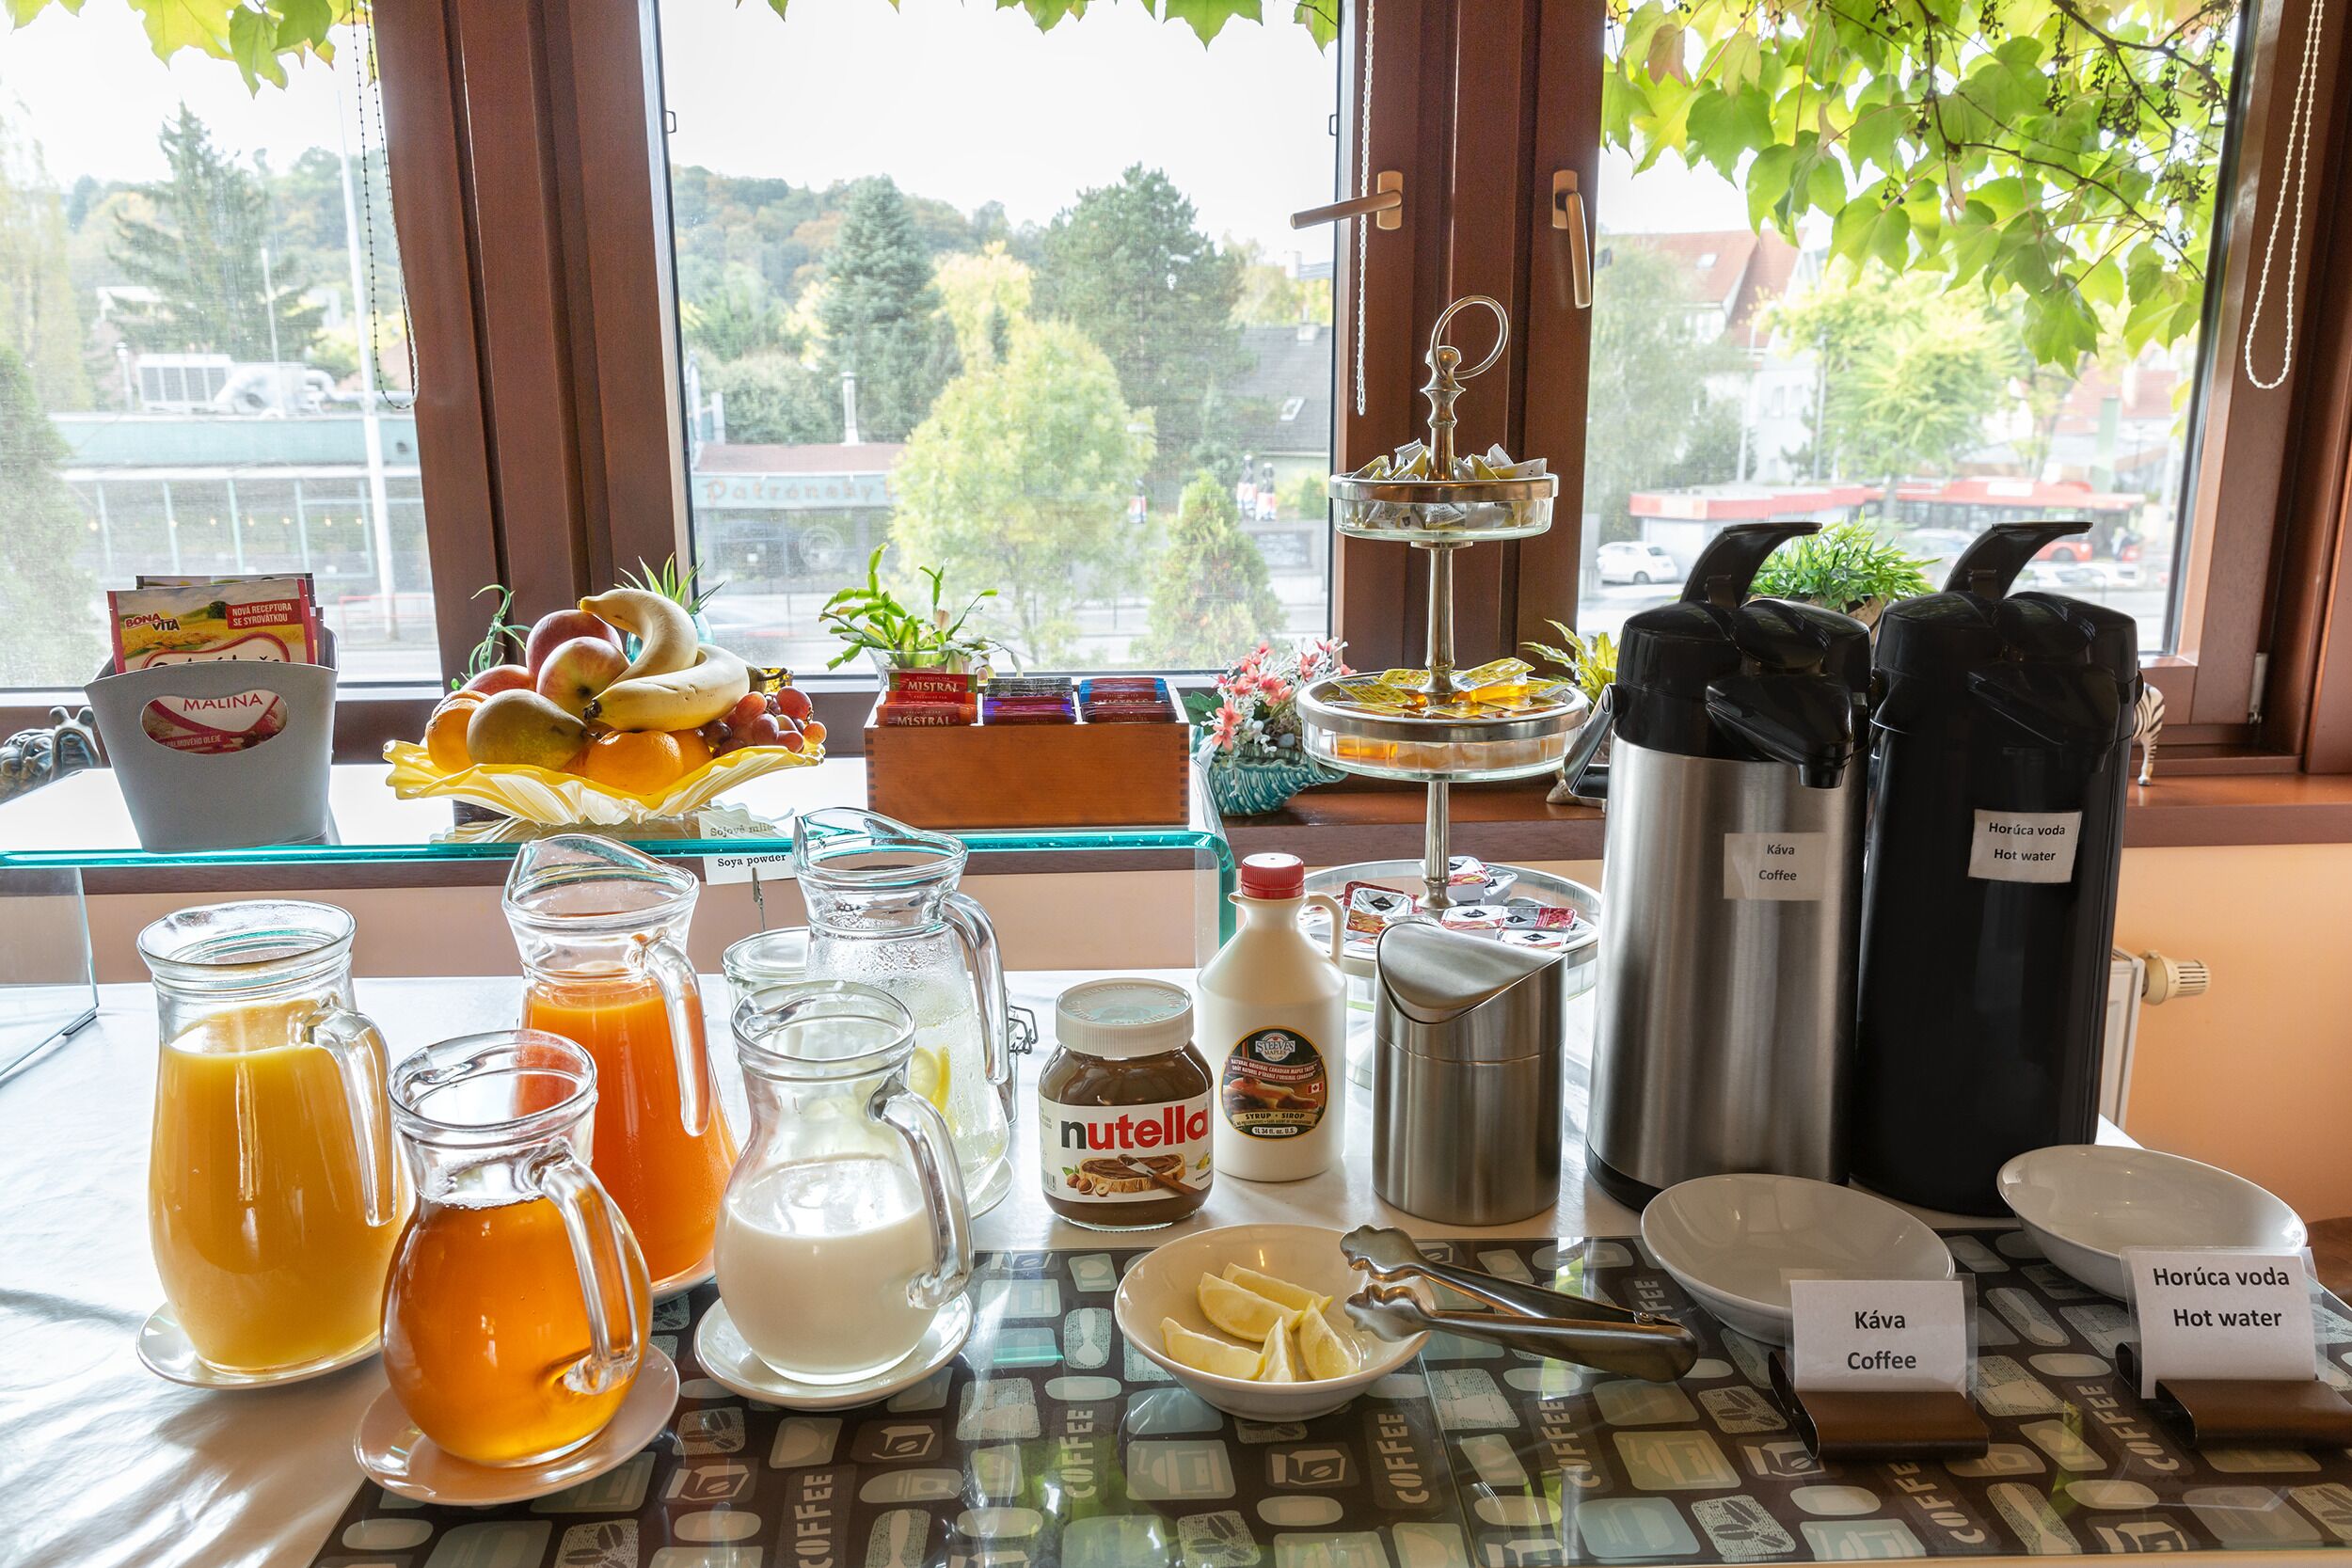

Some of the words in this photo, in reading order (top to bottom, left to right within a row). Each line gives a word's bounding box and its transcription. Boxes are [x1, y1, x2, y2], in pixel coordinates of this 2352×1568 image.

[232, 606, 250, 617] NOVÁ
[251, 602, 293, 613] RECEPTURA
[125, 612, 161, 629] BONA
[151, 618, 181, 631] VITA
[233, 617, 242, 626] SE
[243, 613, 288, 626] SYROVÁTKOU
[907, 681, 960, 692] MISTRAL
[183, 692, 263, 712] MALINA
[897, 716, 950, 726] MISTRAL
[1989, 822, 2034, 835] Horúca
[2038, 825, 2065, 835] voda
[1767, 844, 1795, 855] Káva
[1994, 848, 2017, 860] Hot
[2021, 851, 2057, 862] water
[717, 857, 743, 868] Soya
[746, 854, 787, 866] powder
[1758, 869, 1797, 880] Coffee
[1256, 1040, 1295, 1052] STEEVES
[1248, 1062, 1269, 1072] ORIGINAL
[1268, 1066, 1291, 1074] CANADIAN
[1245, 1112, 1272, 1120] SYRUP
[1060, 1104, 1209, 1151] nutella
[2153, 1266, 2231, 1286] Horúca
[2235, 1266, 2290, 1286] voda
[1854, 1309, 1906, 1329] Káva
[2173, 1308, 2213, 1327] Hot
[2218, 1309, 2282, 1327] water
[1847, 1350, 1916, 1370] Coffee
[2076, 1385, 2180, 1471] COFFEE
[1537, 1401, 1601, 1488] COFFEE
[1058, 1409, 1097, 1498] COFFEE
[1376, 1414, 1430, 1504] COFFEE
[1887, 1462, 1986, 1544] COFFE
